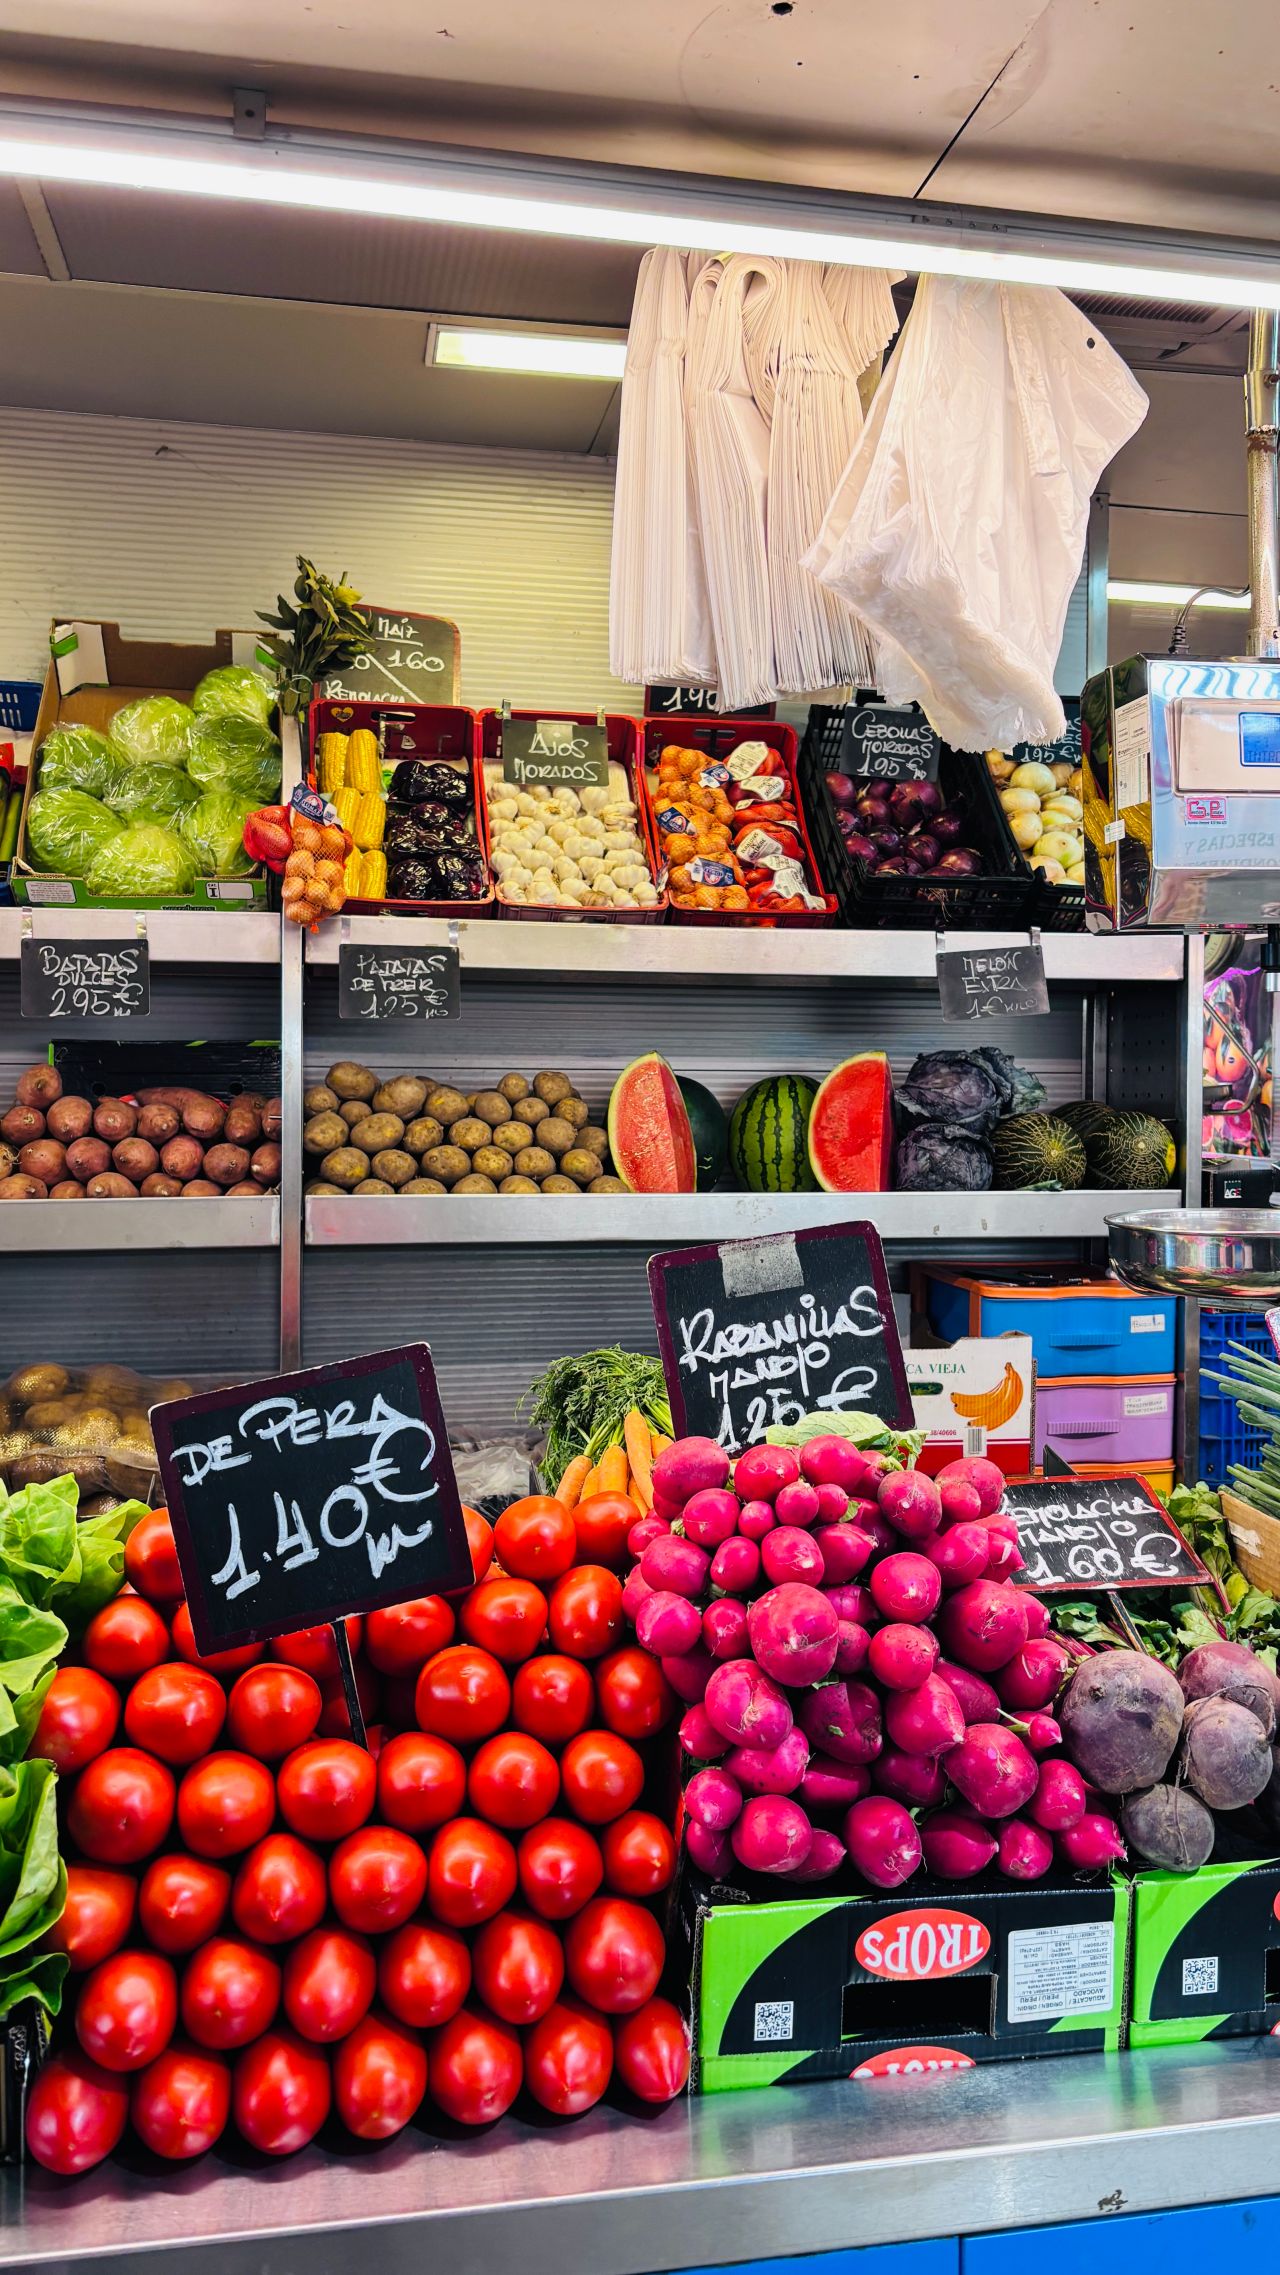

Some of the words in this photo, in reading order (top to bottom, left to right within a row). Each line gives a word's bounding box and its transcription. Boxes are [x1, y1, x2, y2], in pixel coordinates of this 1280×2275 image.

[852, 710, 934, 742] CEBOLLAS
[528, 733, 589, 758] AJOS
[862, 739, 934, 758] MORADAS
[514, 758, 601, 784] MORADOS
[40, 945, 140, 975] BATATAS
[357, 953, 448, 977] PATATAS
[962, 951, 1022, 982] MELÓN
[54, 969, 129, 986] DULCES
[349, 977, 375, 992] DE
[961, 974, 1028, 994] EXTRA
[929, 1363, 966, 1374] VIEJA
[170, 1435, 252, 1486] DE
[238, 1393, 411, 1453] PERA
[863, 1923, 983, 1975] TROPS
[1073, 1988, 1104, 1997] AVOCADO
[1073, 1994, 1106, 2004] AGUACATE
